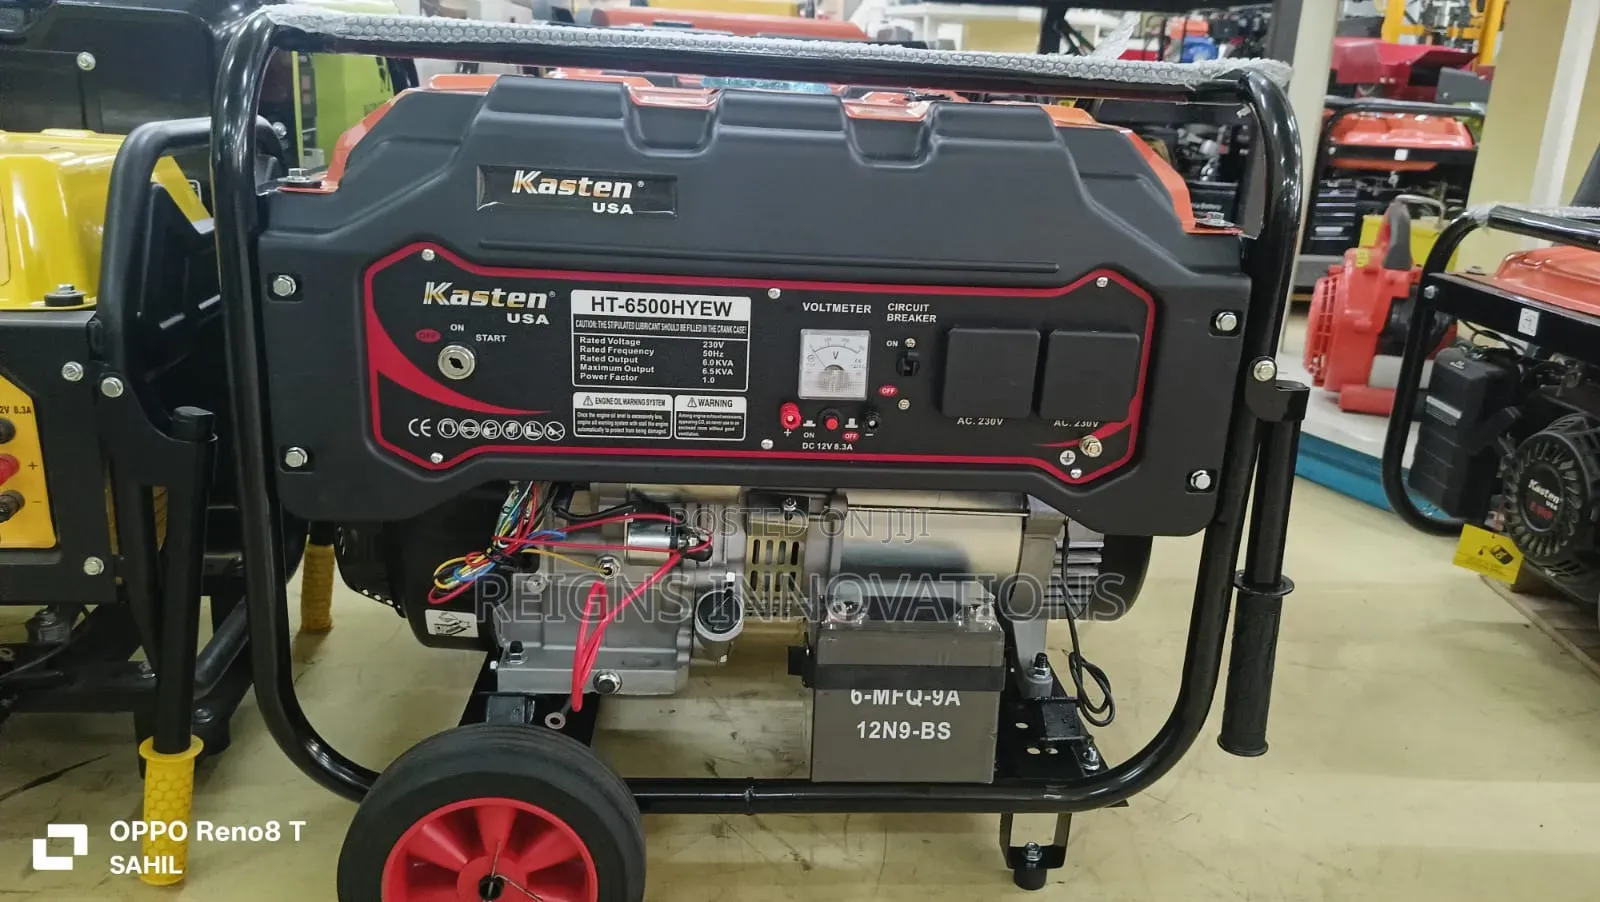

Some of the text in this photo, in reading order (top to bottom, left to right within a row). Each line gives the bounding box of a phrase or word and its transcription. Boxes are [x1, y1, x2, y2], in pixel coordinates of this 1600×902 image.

[511, 169, 633, 199] Kasten
[592, 202, 634, 215] USA
[422, 281, 548, 309] Kasten
[591, 296, 733, 317] HT-6500HYEW
[802, 302, 872, 314] VOLTMETER
[887, 302, 930, 312] CIRCUIT
[506, 312, 550, 325] USA
[886, 313, 937, 323] BREAKER
[450, 323, 465, 332] ON
[598, 320, 607, 329] THE
[607, 320, 635, 330] STIPULATED
[635, 321, 660, 331] LUBRICANT
[660, 322, 680, 332] SHOULD
[680, 323, 686, 332] BE
[687, 323, 701, 332] FILLED
[702, 324, 708, 332] IN
[708, 324, 717, 333] THE
[717, 325, 733, 334] CRANK
[419, 332, 437, 340] OFF
[475, 333, 507, 343] START
[580, 336, 725, 349] Rated Voltage 230V
[580, 345, 725, 358] Rated Frequency 50Hz
[832, 351, 839, 360] V
[580, 354, 606, 362] Rated
[607, 355, 639, 365] Output
[580, 363, 622, 372] Maximum
[624, 364, 655, 374] Output
[580, 372, 716, 384] Power Factor 1.0
[881, 386, 896, 394] OFF
[595, 397, 666, 407] ENGINE OIL WARNING SYSTEM
[698, 398, 733, 408] WARNING
[956, 417, 1004, 426] AC. 230V
[1074, 420, 1099, 428] 230V
[408, 418, 432, 437] CE
[802, 442, 854, 451] DC 12V 8.3A
[1528, 479, 1560, 504] Kasten
[850, 689, 961, 707] 6-MFQ-9A
[856, 720, 951, 740] 12N9-BS
